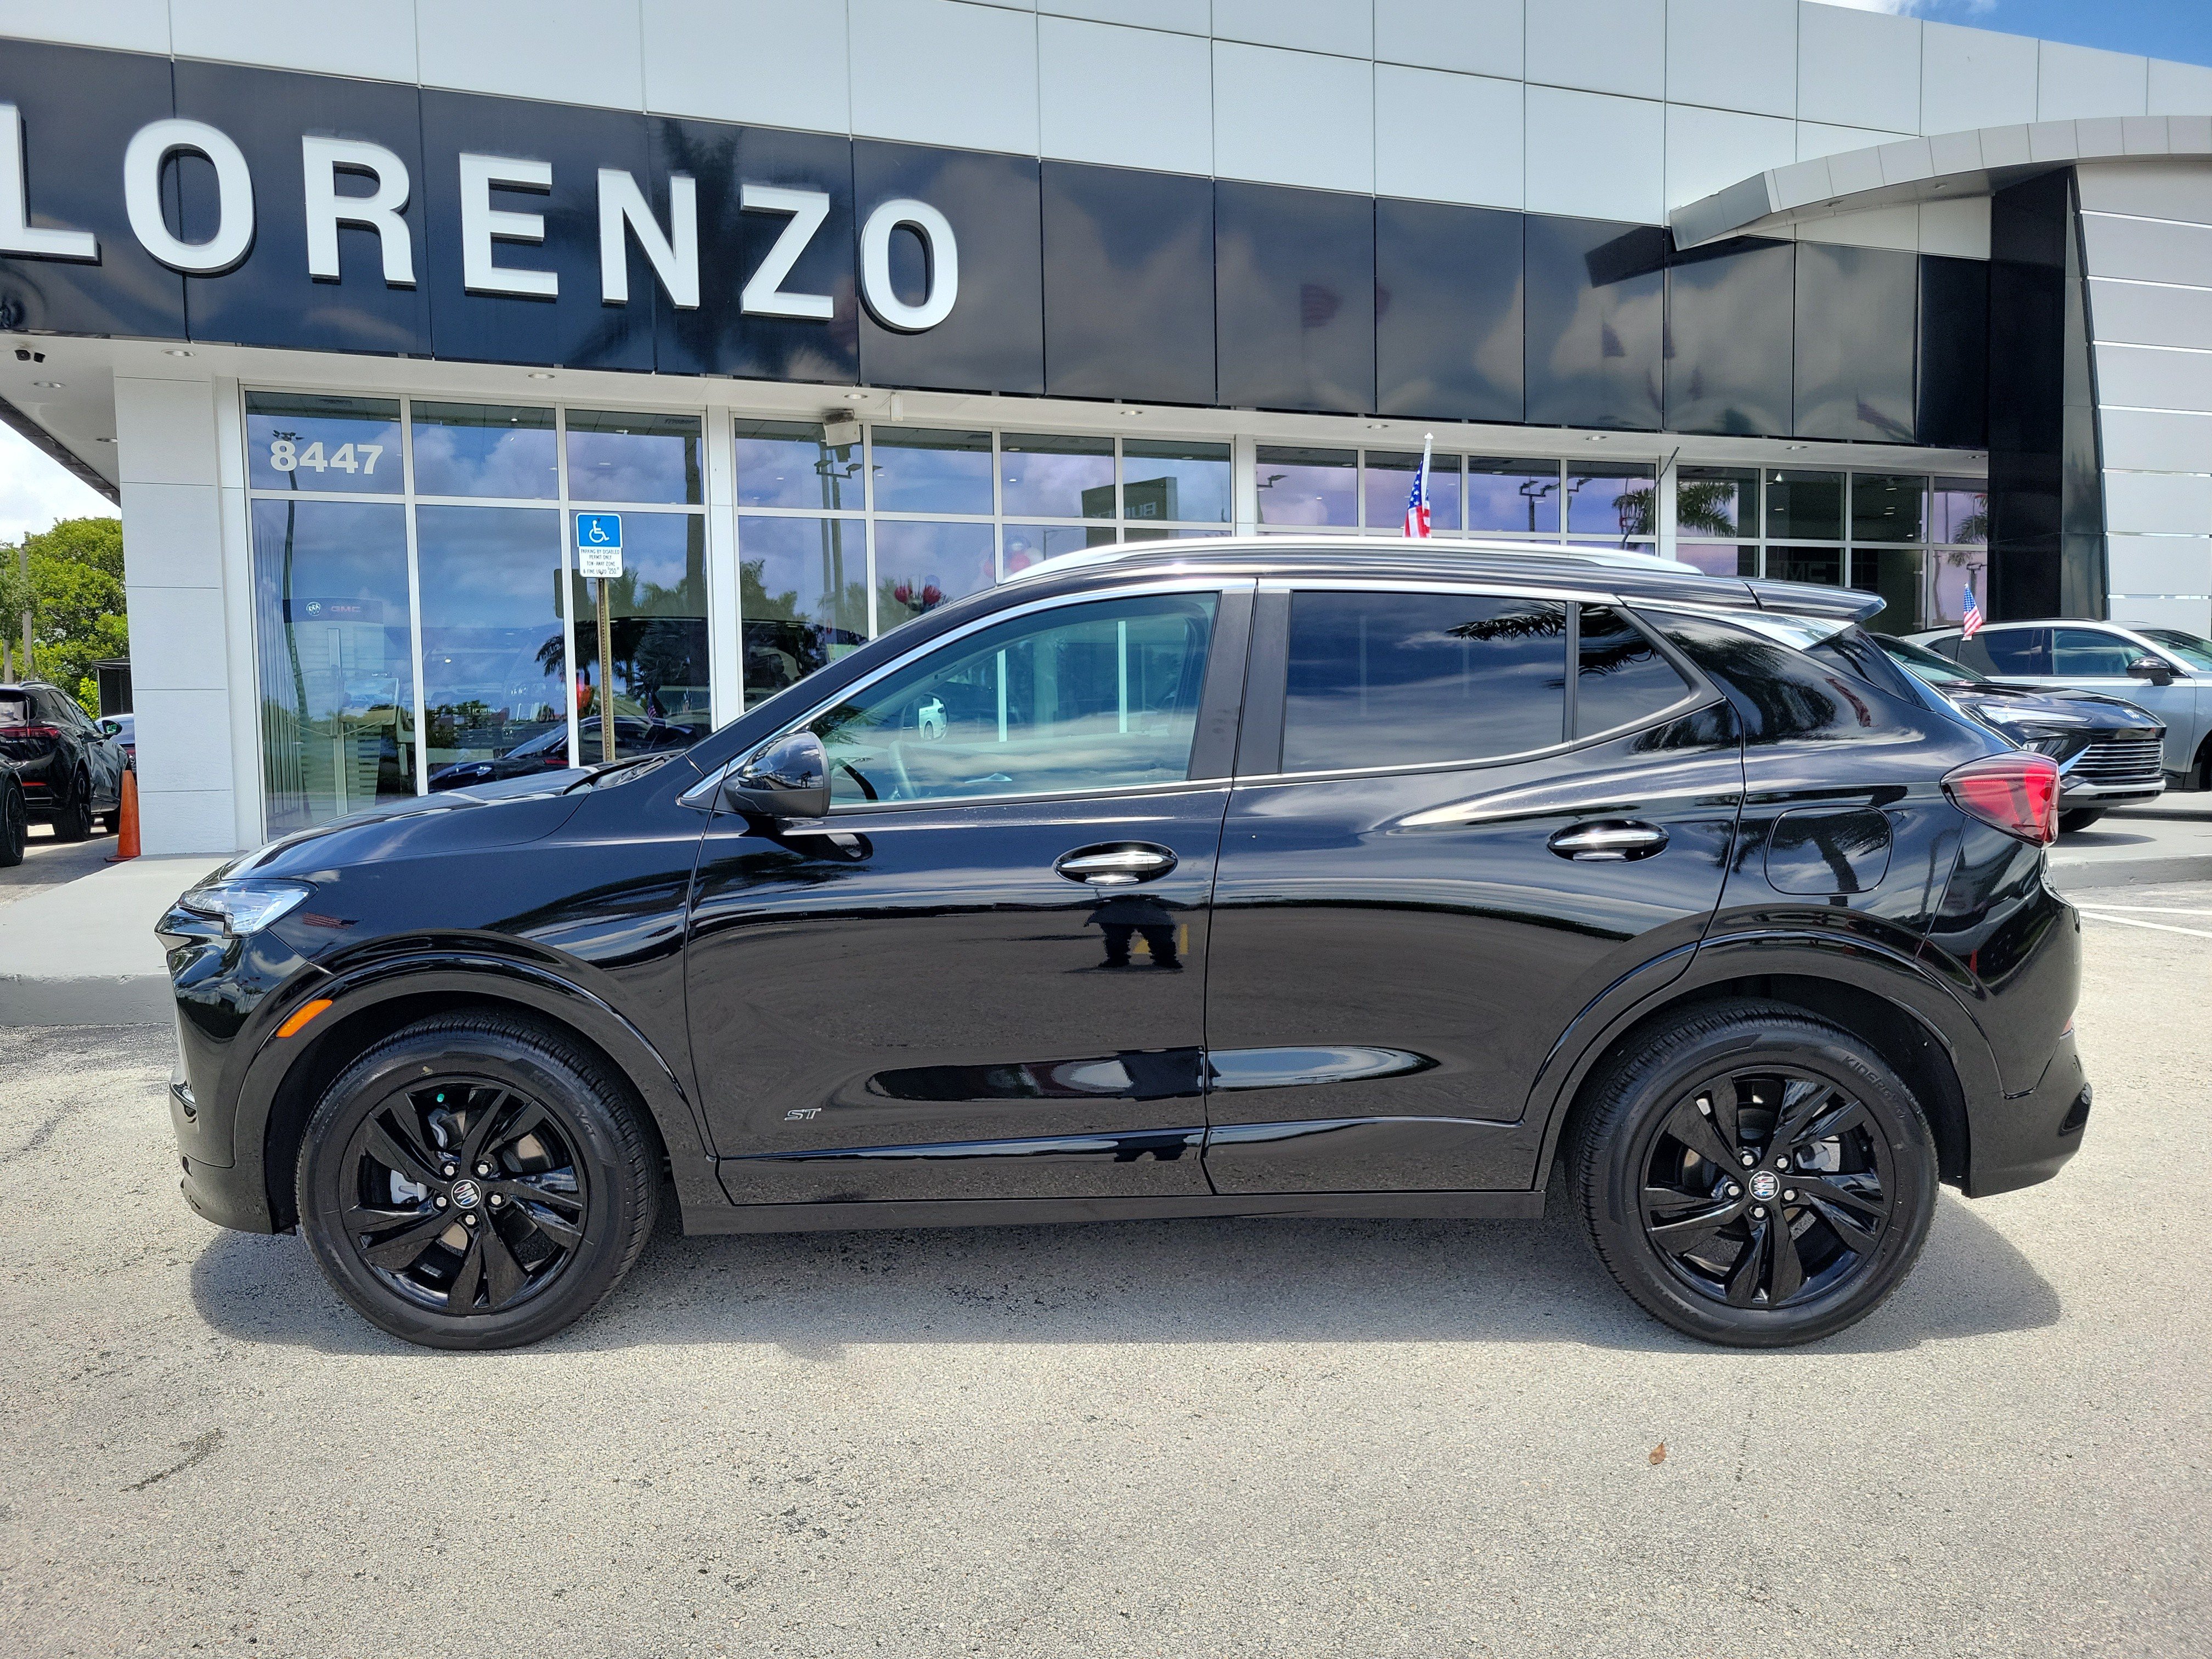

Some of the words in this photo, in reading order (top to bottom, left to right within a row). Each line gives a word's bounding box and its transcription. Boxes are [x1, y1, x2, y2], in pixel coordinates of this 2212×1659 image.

[0, 103, 959, 330] LORENZO
[270, 440, 383, 475] 8447
[784, 1108, 822, 1121] ST
